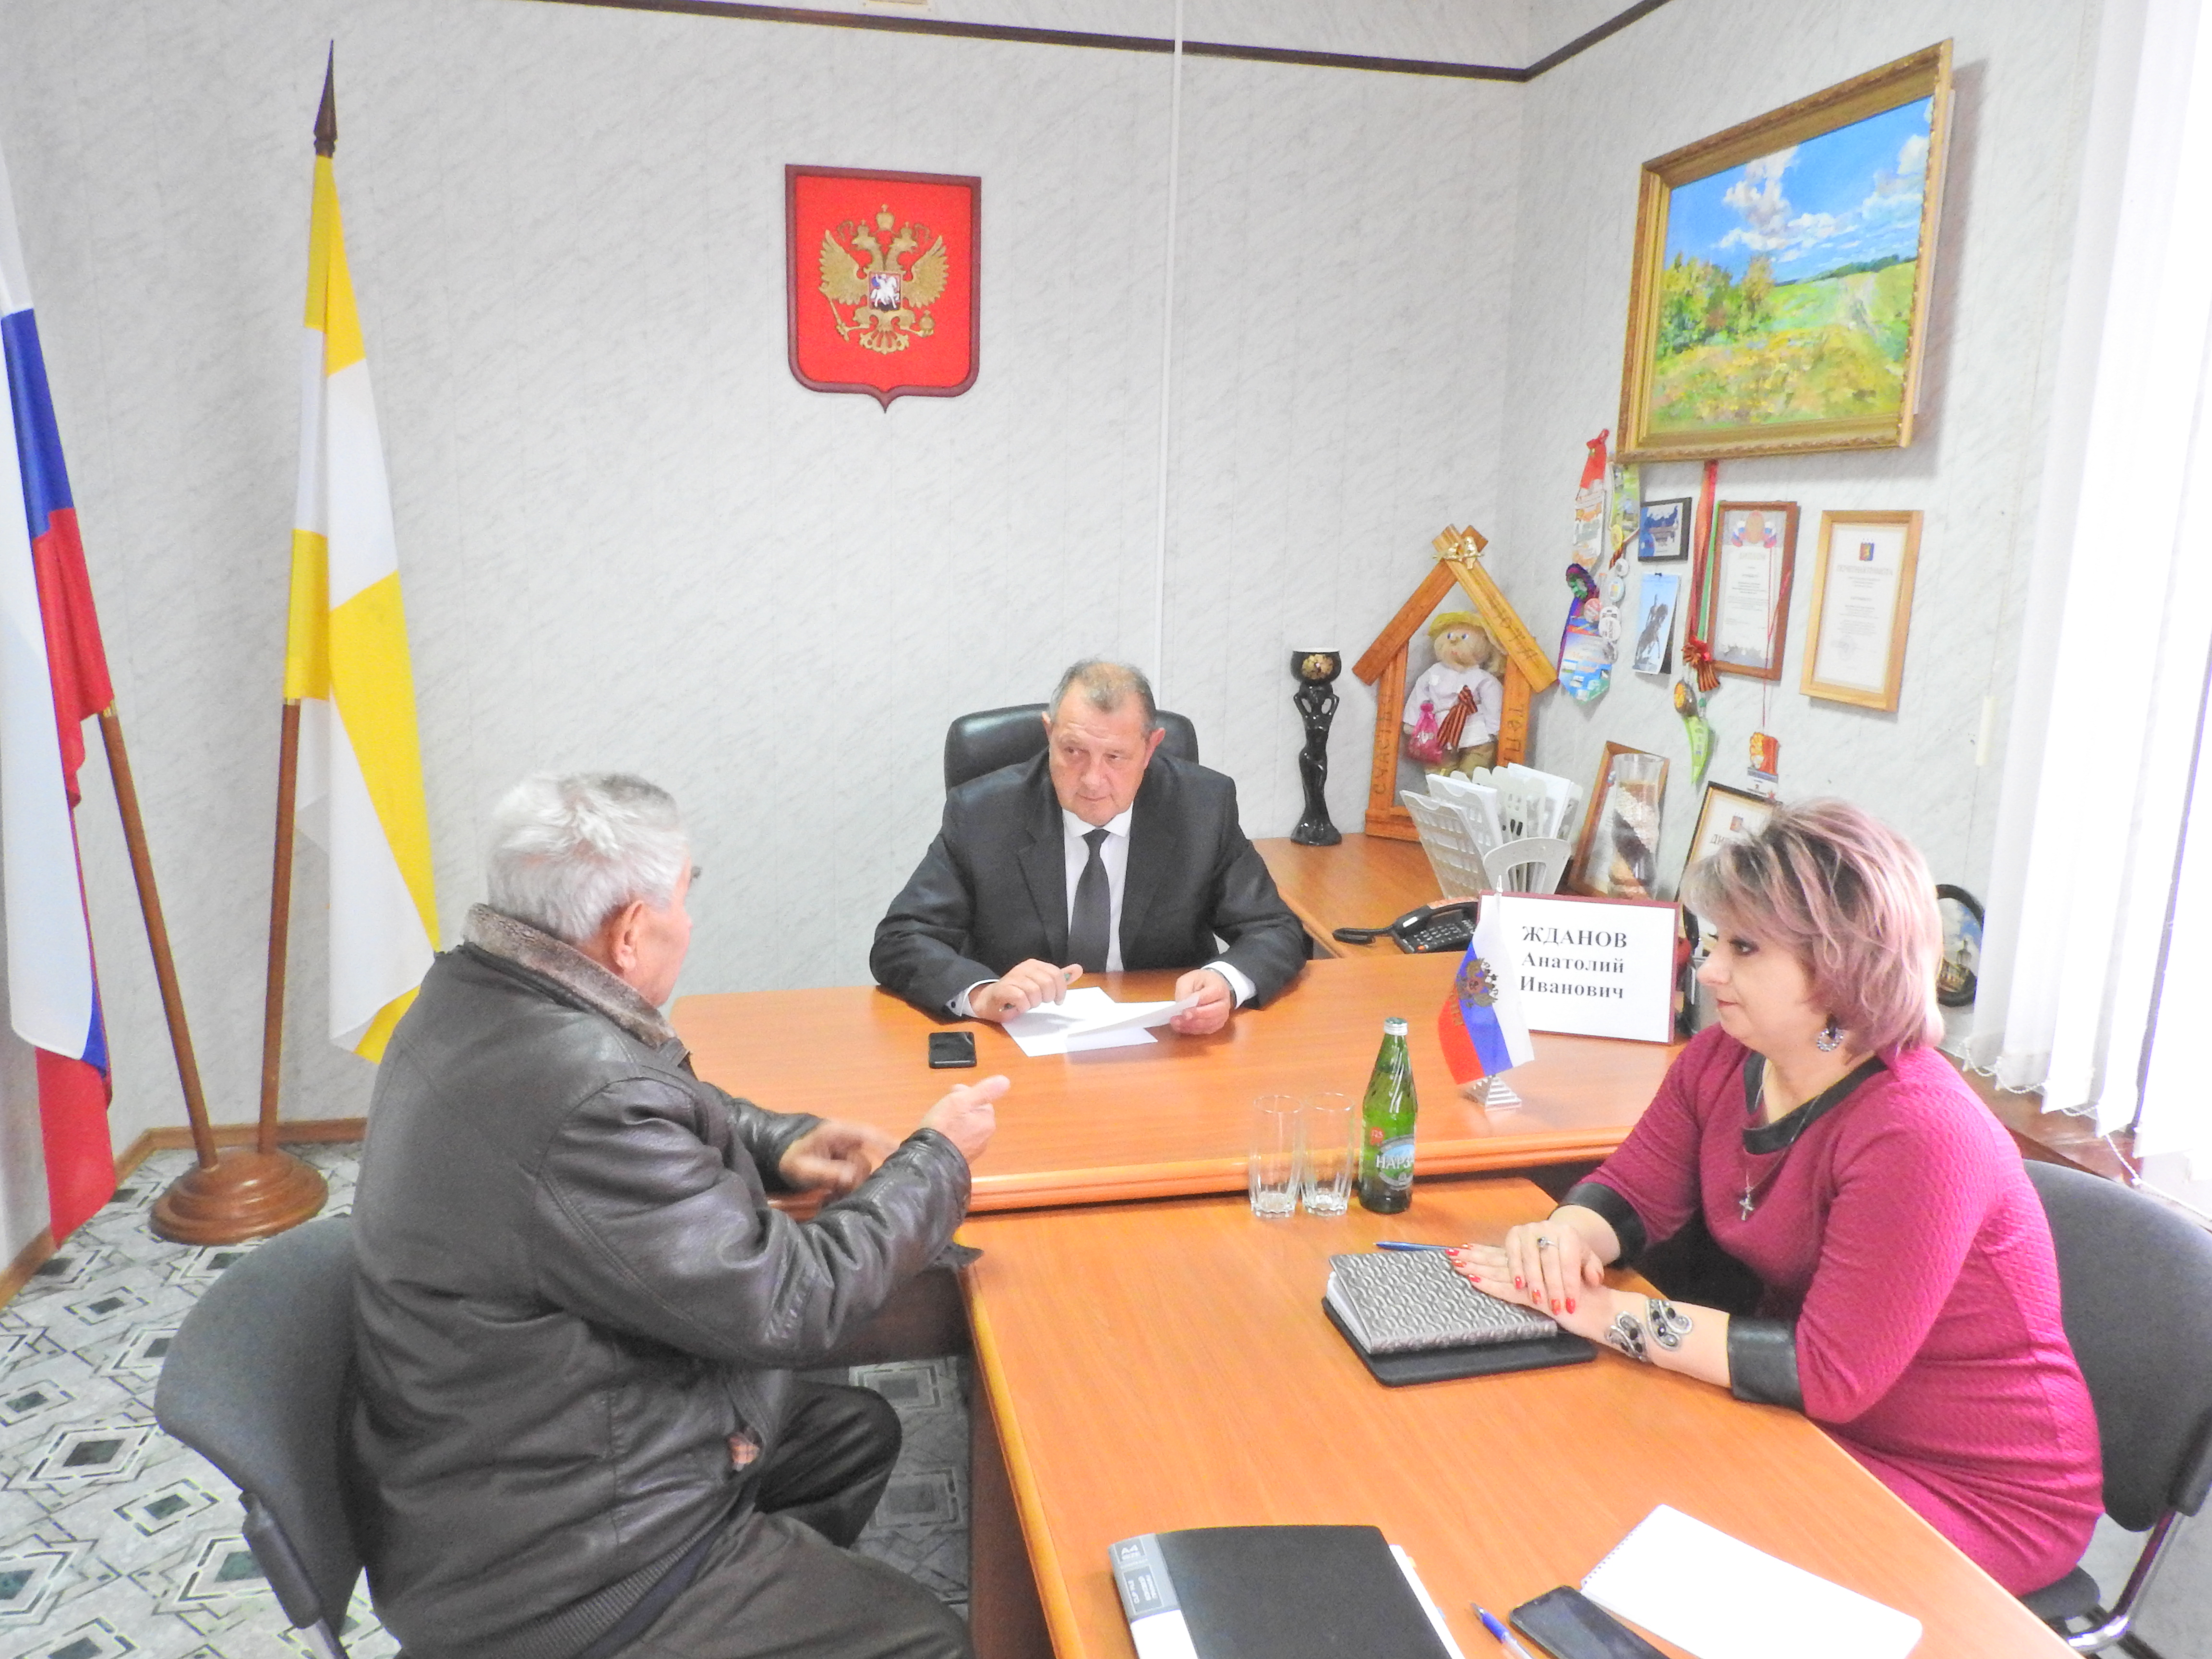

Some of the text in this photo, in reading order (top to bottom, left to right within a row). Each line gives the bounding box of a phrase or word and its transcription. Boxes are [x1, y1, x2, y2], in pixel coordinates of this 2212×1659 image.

[1522, 925, 1627, 948] ЖДАНОВ
[1521, 951, 1624, 974] Анатолий
[1519, 975, 1624, 999] Иванович
